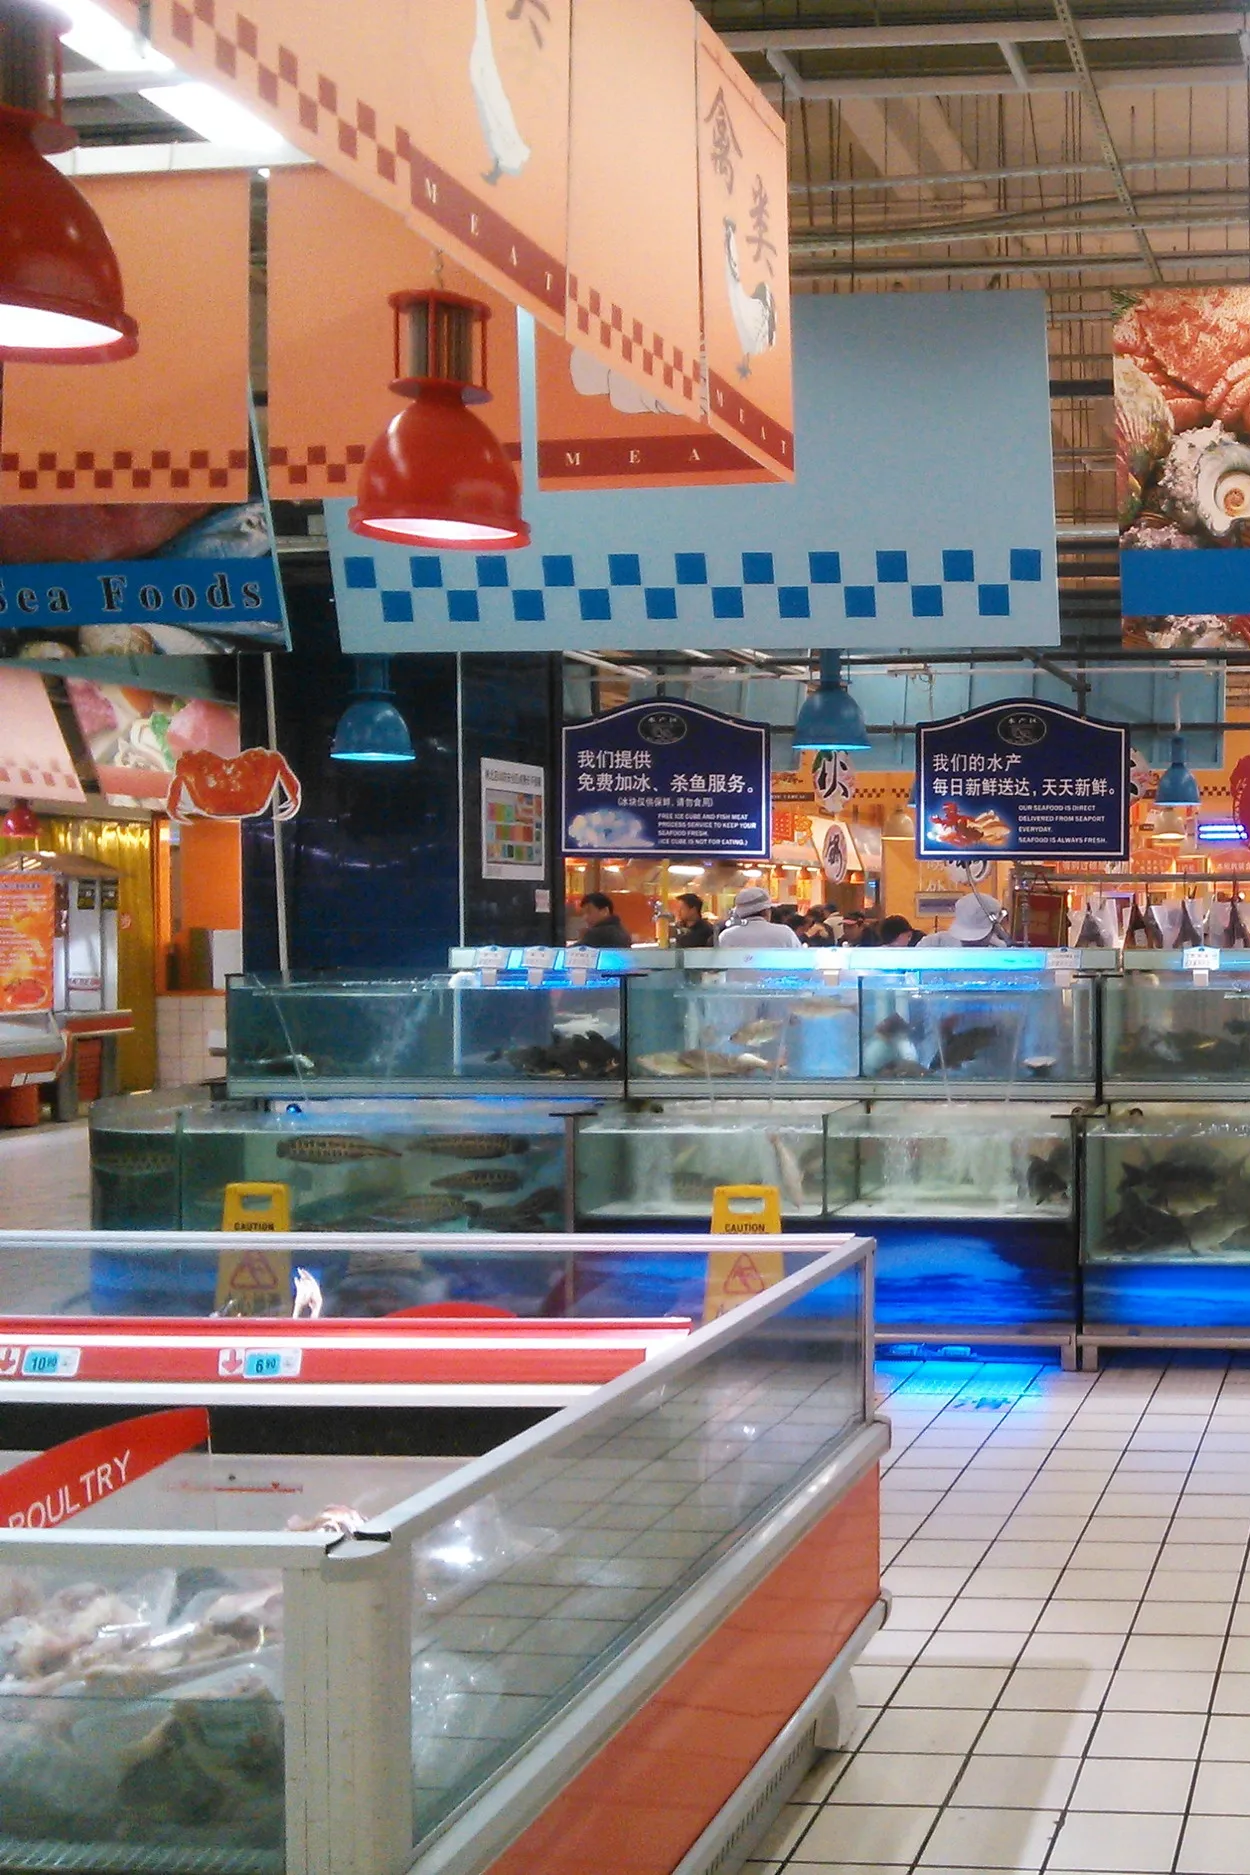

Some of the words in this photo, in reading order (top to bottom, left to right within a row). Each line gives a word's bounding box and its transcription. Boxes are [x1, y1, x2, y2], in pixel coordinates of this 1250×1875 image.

[0, 577, 72, 614] ea
[97, 571, 263, 613] Foods
[577, 750, 652, 770] 我们提供
[932, 753, 1022, 773] 我们的水产
[234, 1222, 276, 1232] CAUTION
[724, 1223, 766, 1233] CAUTION
[8, 1449, 131, 1528] POULTRY
